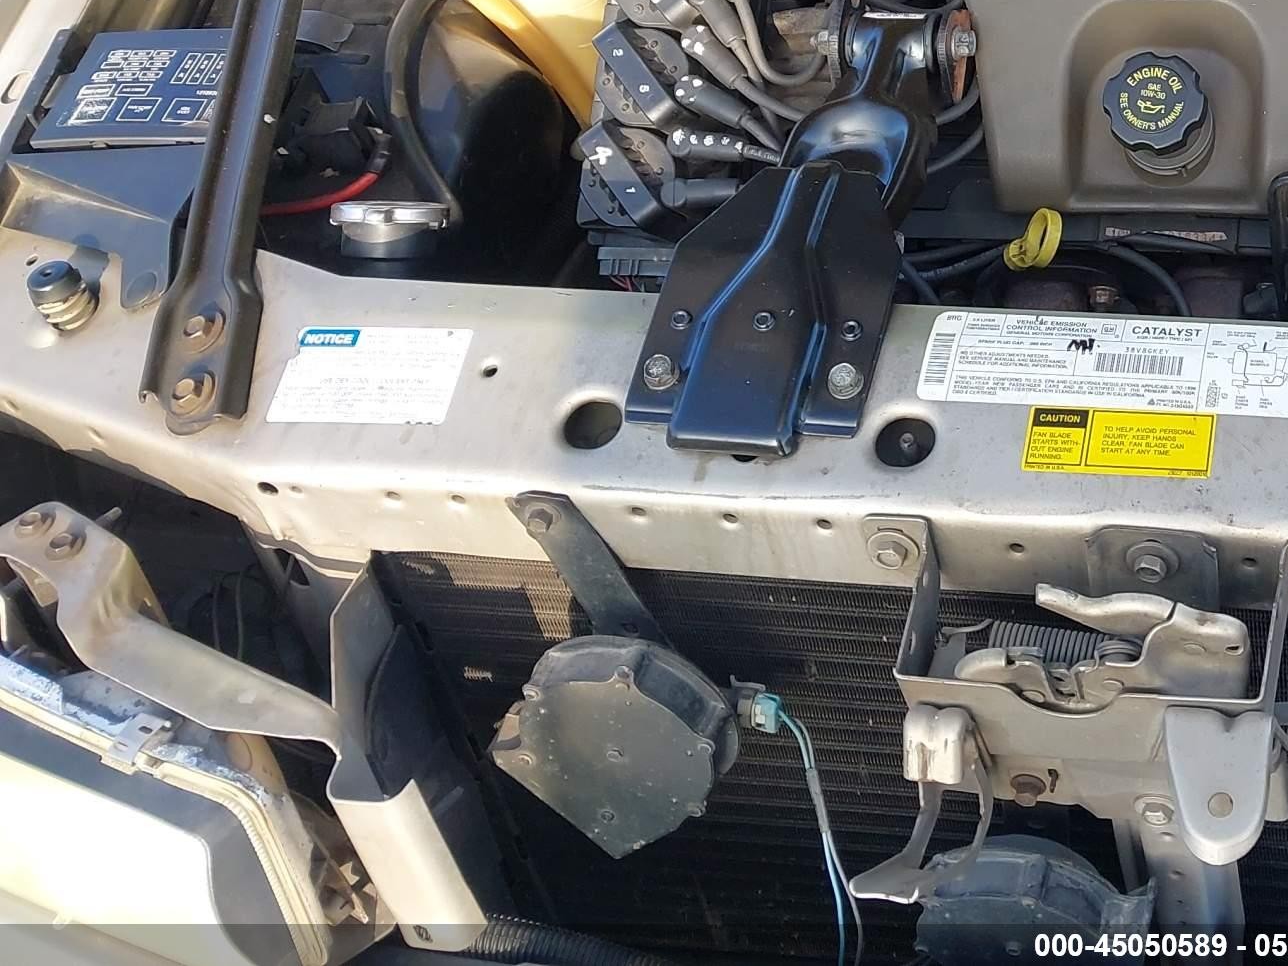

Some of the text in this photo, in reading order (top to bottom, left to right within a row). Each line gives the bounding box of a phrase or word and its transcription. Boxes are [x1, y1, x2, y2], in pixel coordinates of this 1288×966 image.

[1126, 67, 1184, 94] ENGINE OIL
[1147, 83, 1162, 91] SAE
[1140, 89, 1166, 100] 10W-30
[1119, 92, 1185, 130] SEE OWNER'S MANUAL
[1006, 324, 1044, 332] CONTROL
[1044, 325, 1098, 333] INFORMATION
[1132, 326, 1202, 338] CATALYST
[304, 333, 355, 345] NOTICE
[1039, 413, 1081, 423] CAUTION
